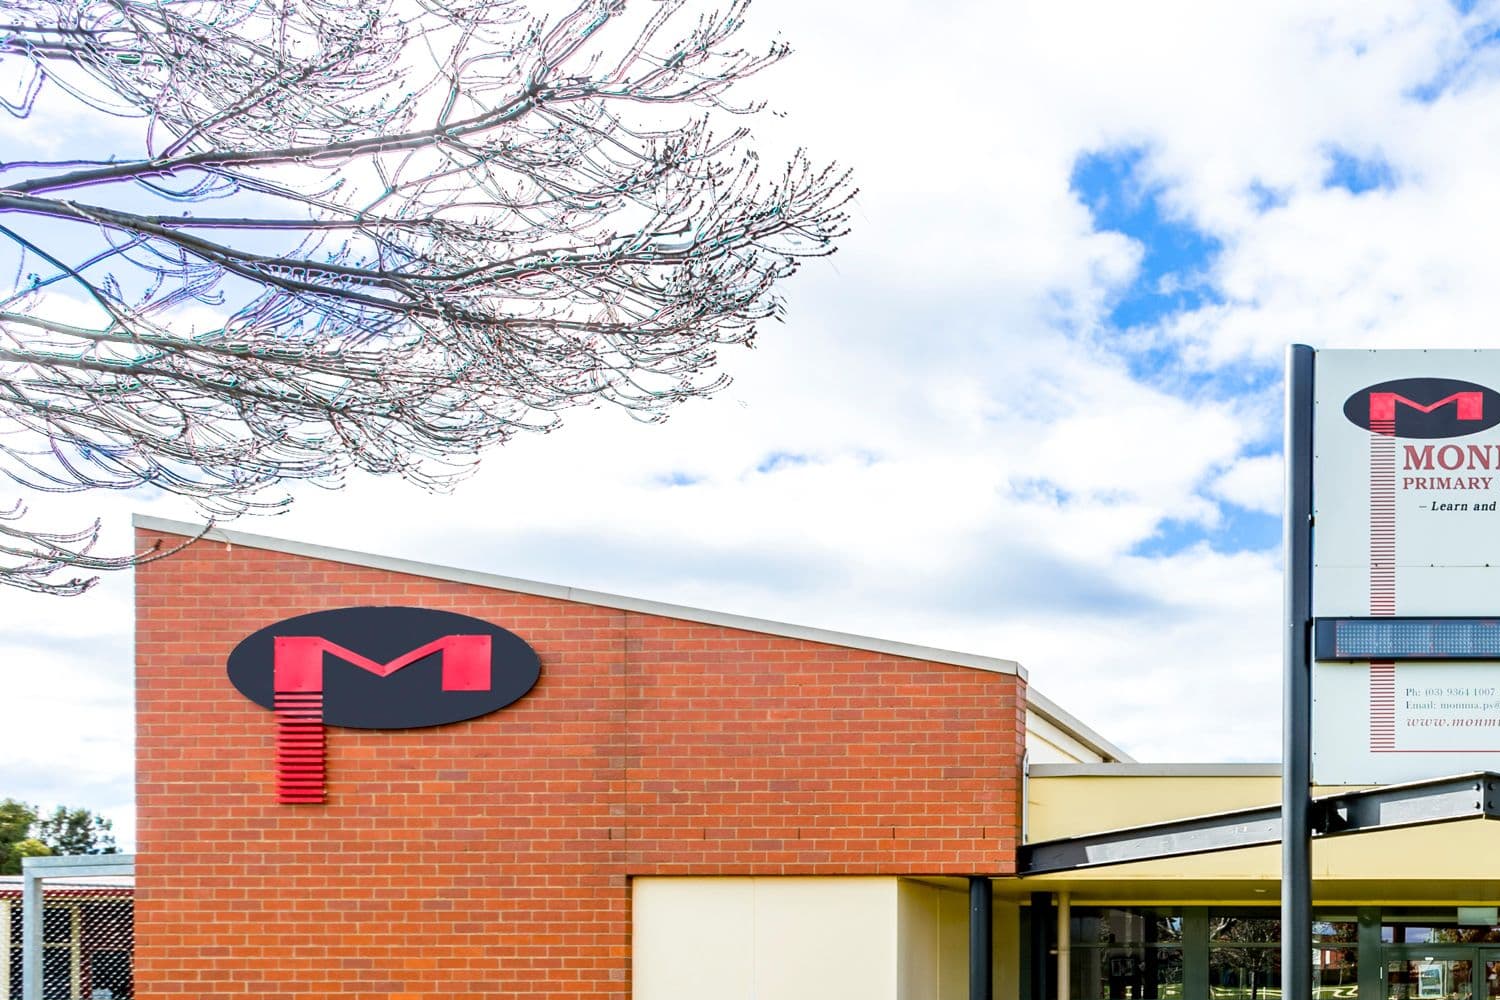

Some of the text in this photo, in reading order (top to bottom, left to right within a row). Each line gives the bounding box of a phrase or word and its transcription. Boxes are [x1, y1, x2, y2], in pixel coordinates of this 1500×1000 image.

[1402, 476, 1494, 490] PRIMARY
[1430, 500, 1469, 512] Learn
[1472, 500, 1497, 512] and
[1405, 687, 1421, 697] Ph:
[1425, 687, 1443, 697] (03)
[1405, 700, 1436, 710] Email:
